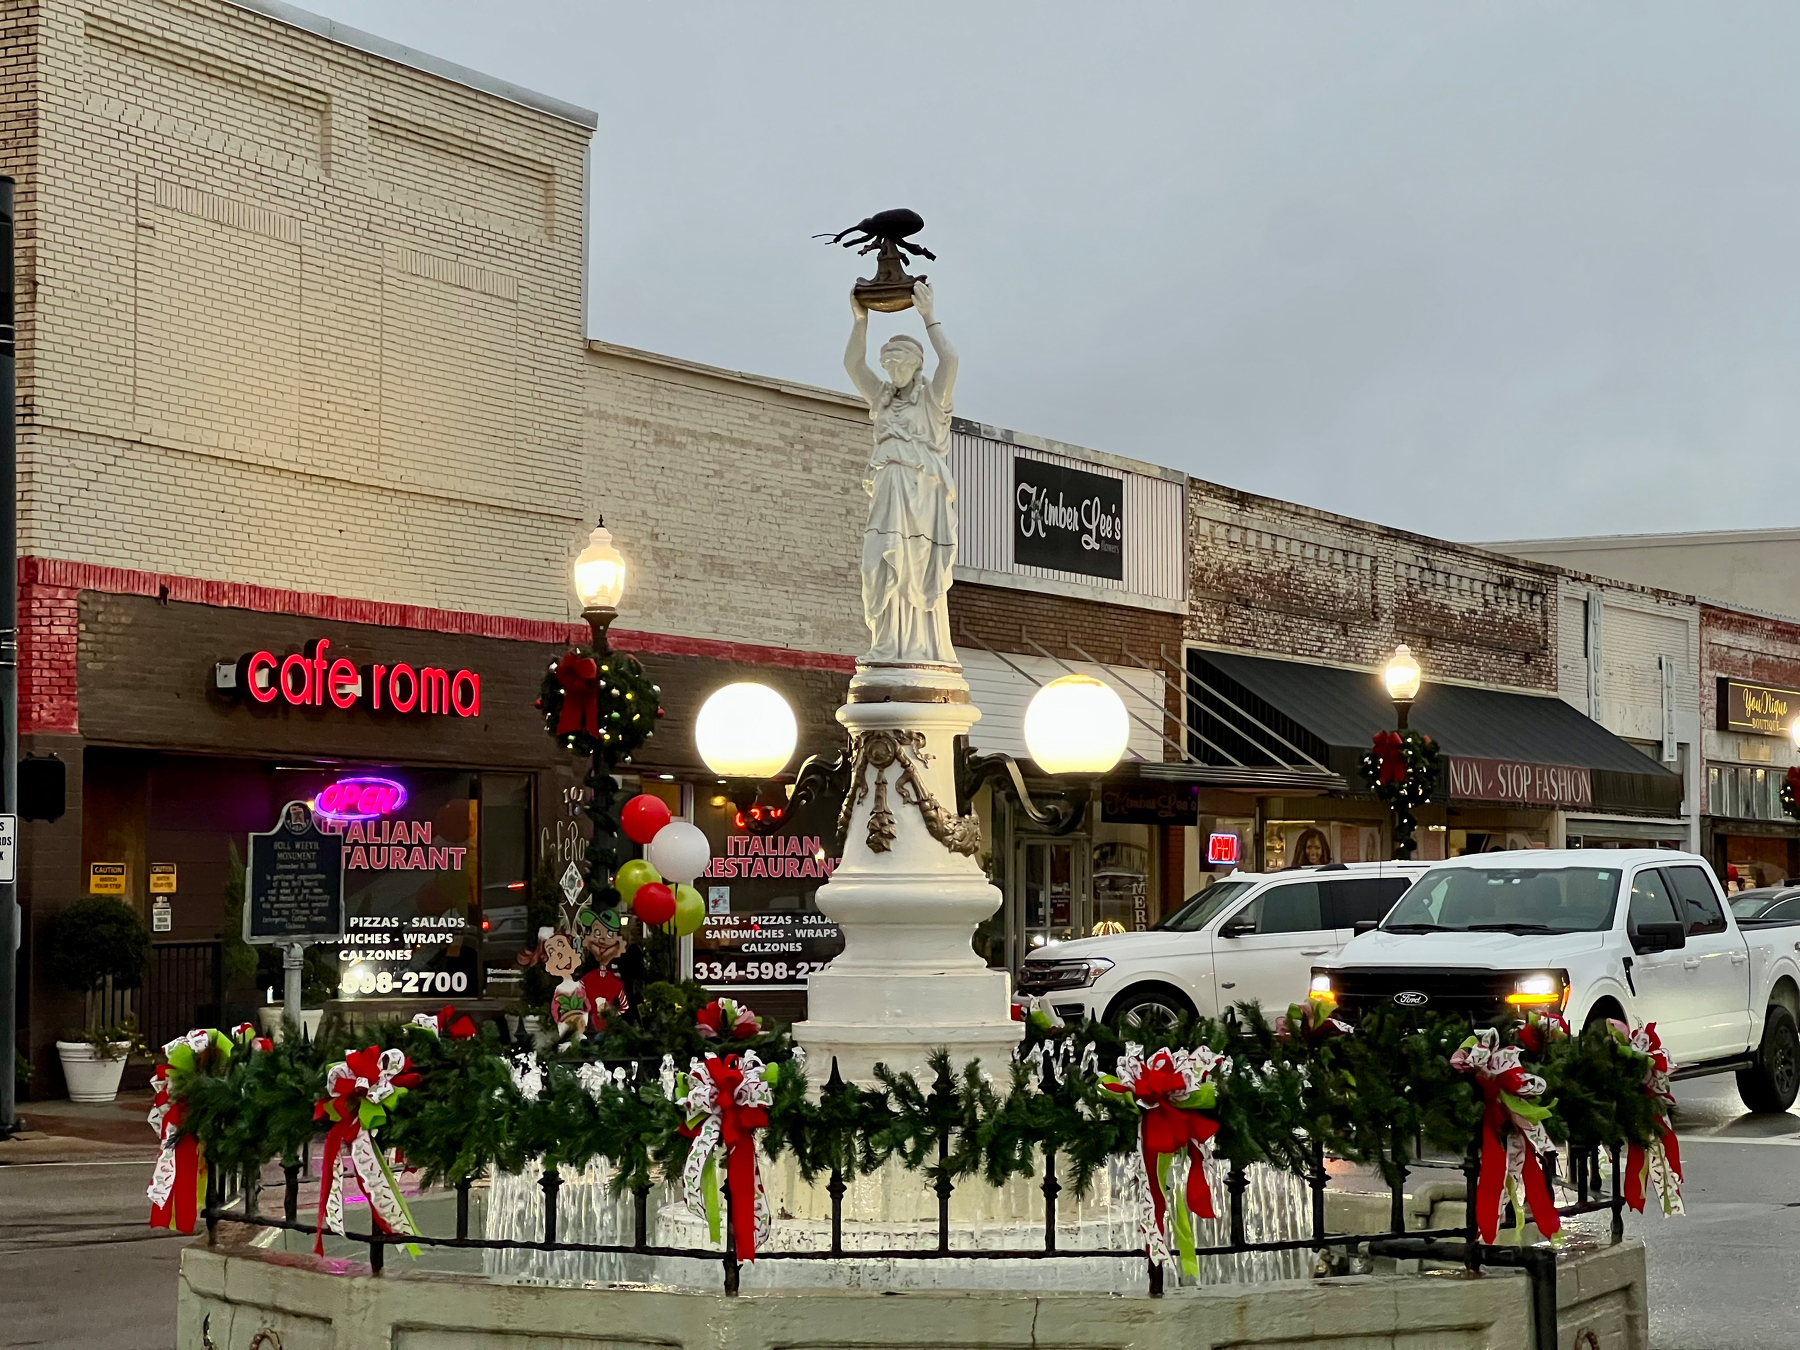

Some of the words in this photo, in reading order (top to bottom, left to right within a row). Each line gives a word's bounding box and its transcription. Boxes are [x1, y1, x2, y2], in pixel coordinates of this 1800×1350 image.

[1017, 483, 1079, 538] Kimber
[1081, 497, 1121, 550] Lee's
[248, 638, 358, 708] cafe
[373, 663, 480, 717] roma
[1752, 718, 1780, 731] BOUTIQUE
[1450, 760, 1483, 795] NON
[1498, 764, 1532, 802] STOP
[1536, 767, 1592, 803] FASHION
[320, 784, 397, 814] OPEN
[727, 836, 820, 856] ITALIAN
[1210, 836, 1236, 861] OPEN
[276, 852, 316, 860] MONUMENT
[341, 846, 467, 871] TAURANT
[350, 917, 399, 928] PIZZAS
[411, 917, 465, 928] SALADS
[703, 916, 740, 925] ASTAS
[750, 915, 792, 925] PIZZAS
[802, 915, 838, 924] SALA
[403, 933, 453, 944] WRAPS
[705, 929, 785, 939] SANDWICHES
[795, 928, 837, 938] WRAPS
[741, 942, 803, 952] CALZONES
[339, 949, 412, 961] CALZONES
[694, 962, 832, 980] 334-598-27
[340, 972, 468, 994] 598-2700
[1401, 994, 1421, 1003] Ford
